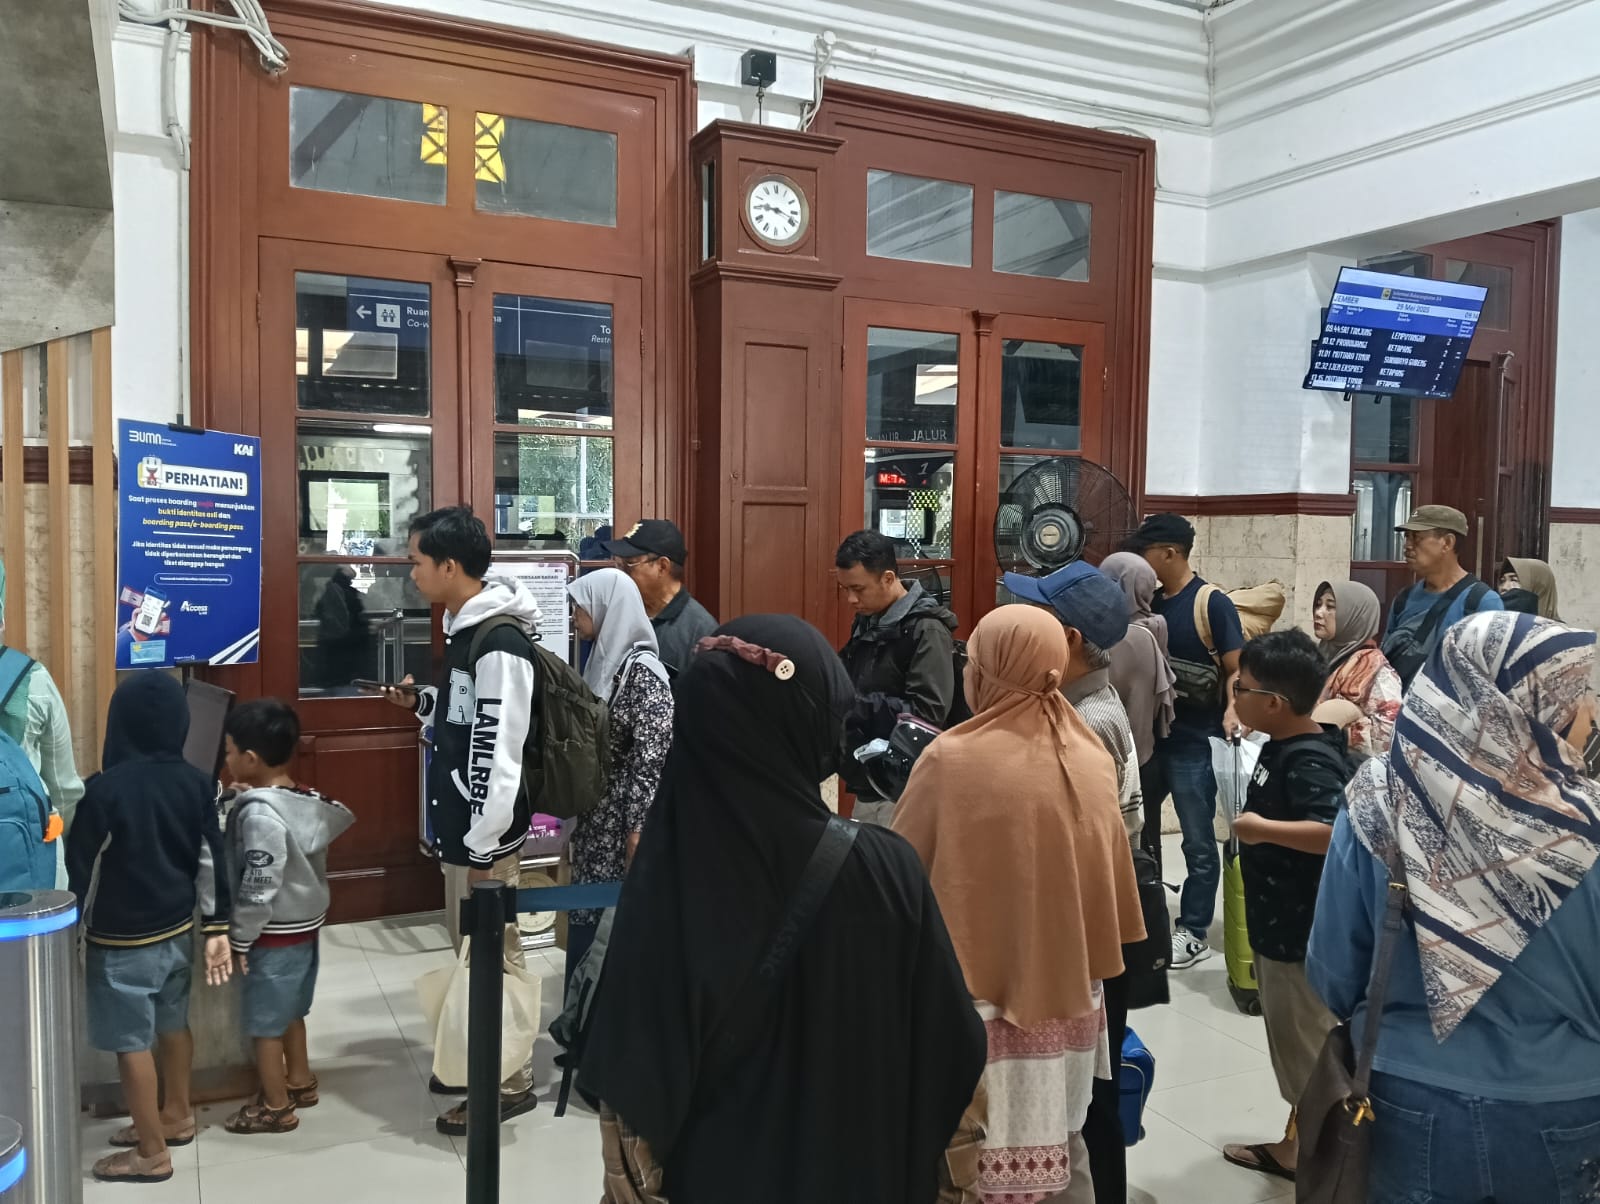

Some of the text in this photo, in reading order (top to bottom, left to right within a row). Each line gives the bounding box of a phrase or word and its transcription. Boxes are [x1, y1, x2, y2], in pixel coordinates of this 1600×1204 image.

[1446, 338, 1453, 346] 2
[1442, 349, 1448, 357] 2
[1439, 361, 1444, 369] 2
[911, 429, 947, 441] JALUR
[233, 443, 253, 456] KAI
[165, 471, 243, 490] PERHATIAN!
[128, 494, 144, 503] Saat
[168, 498, 197, 508] boarding
[158, 507, 176, 515] bukti
[143, 517, 174, 528] boarding
